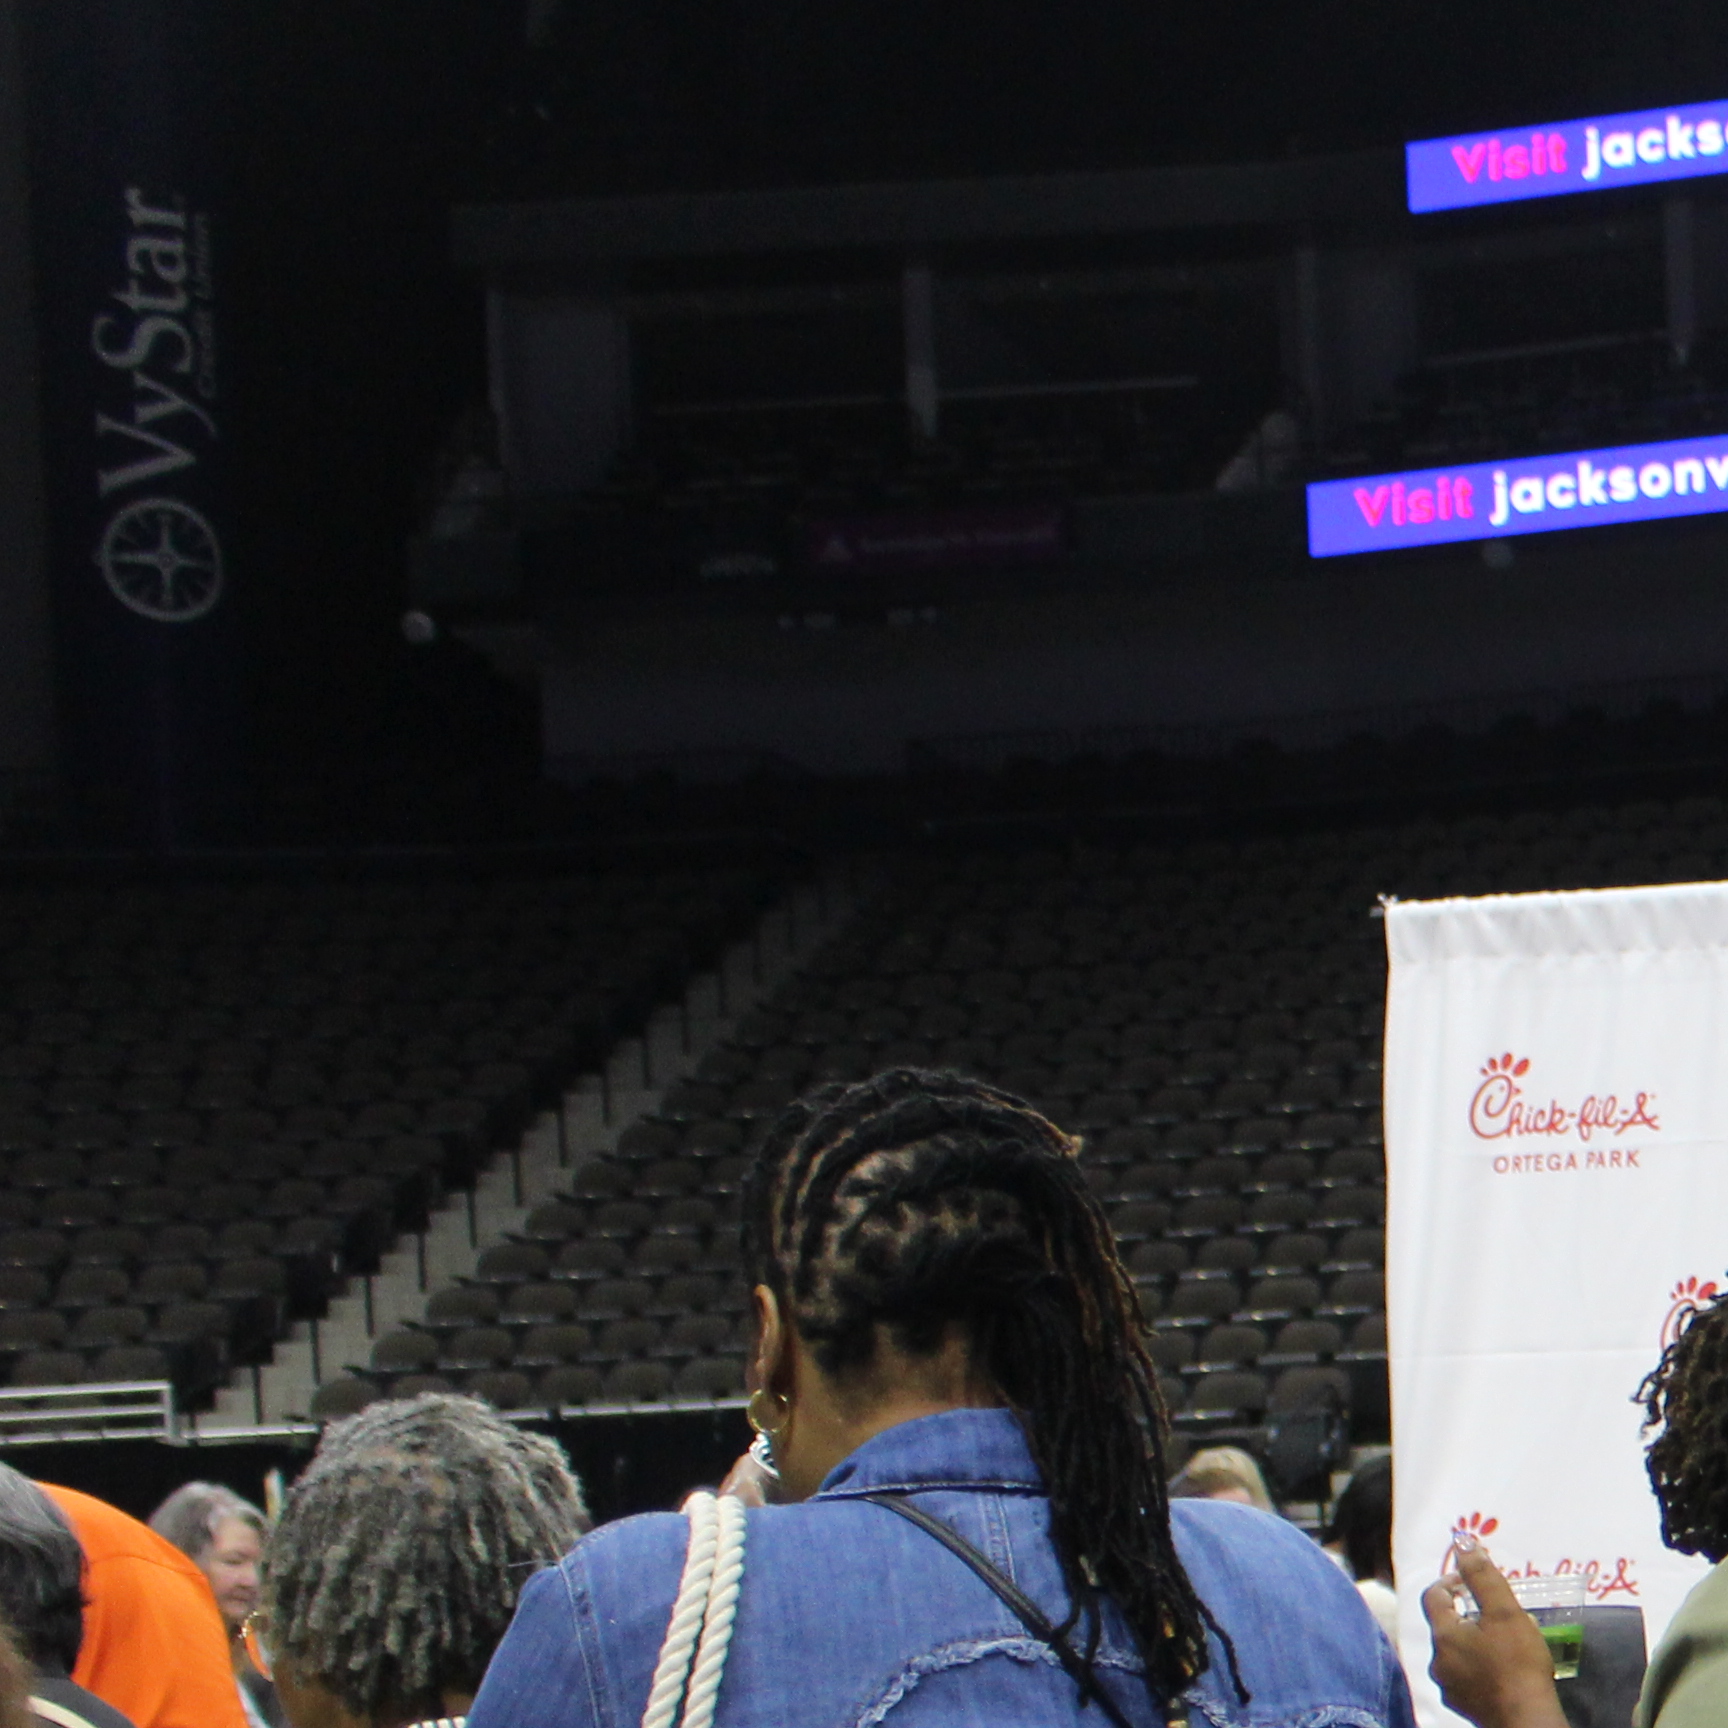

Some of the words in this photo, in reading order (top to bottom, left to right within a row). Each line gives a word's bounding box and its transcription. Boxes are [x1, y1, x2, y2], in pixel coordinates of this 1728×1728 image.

[1450, 141, 1569, 185] Visit
[91, 185, 219, 498] VyStar
[1352, 481, 1476, 529] Visit
[1469, 1075, 1660, 1141] Chick-fil-A
[1492, 1152, 1577, 1174] ORTEGA
[1585, 1150, 1640, 1169] PARK
